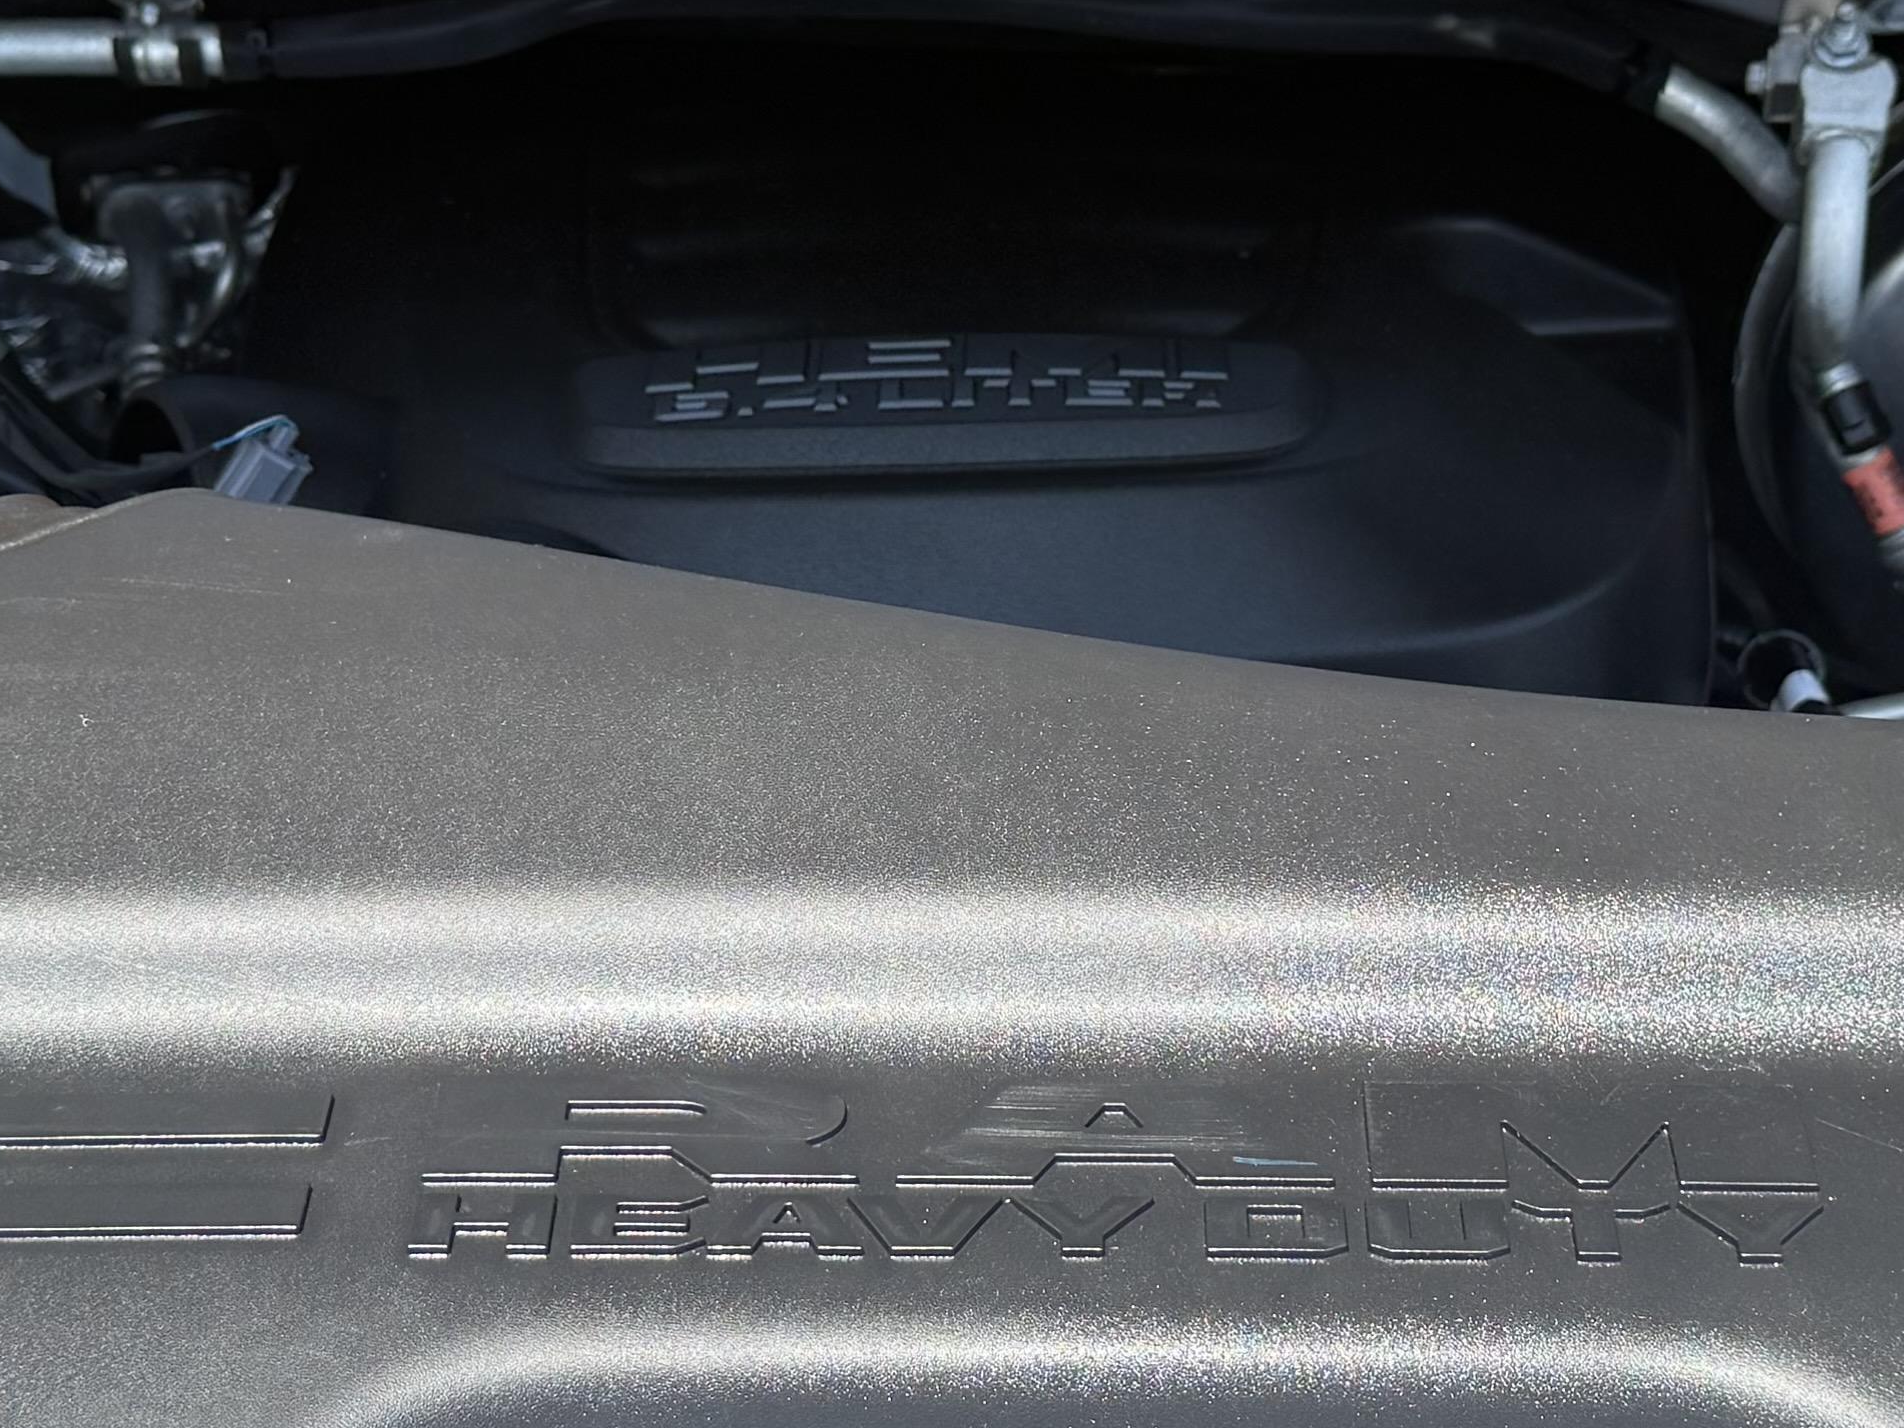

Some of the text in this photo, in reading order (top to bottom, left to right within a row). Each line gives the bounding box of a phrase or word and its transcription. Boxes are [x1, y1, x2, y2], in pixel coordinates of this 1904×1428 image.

[644, 335, 1229, 394] HEMI
[877, 375, 1222, 409] LITER
[420, 1079, 1820, 1190] RAM
[406, 1193, 1826, 1266] HEAVY DUTY
